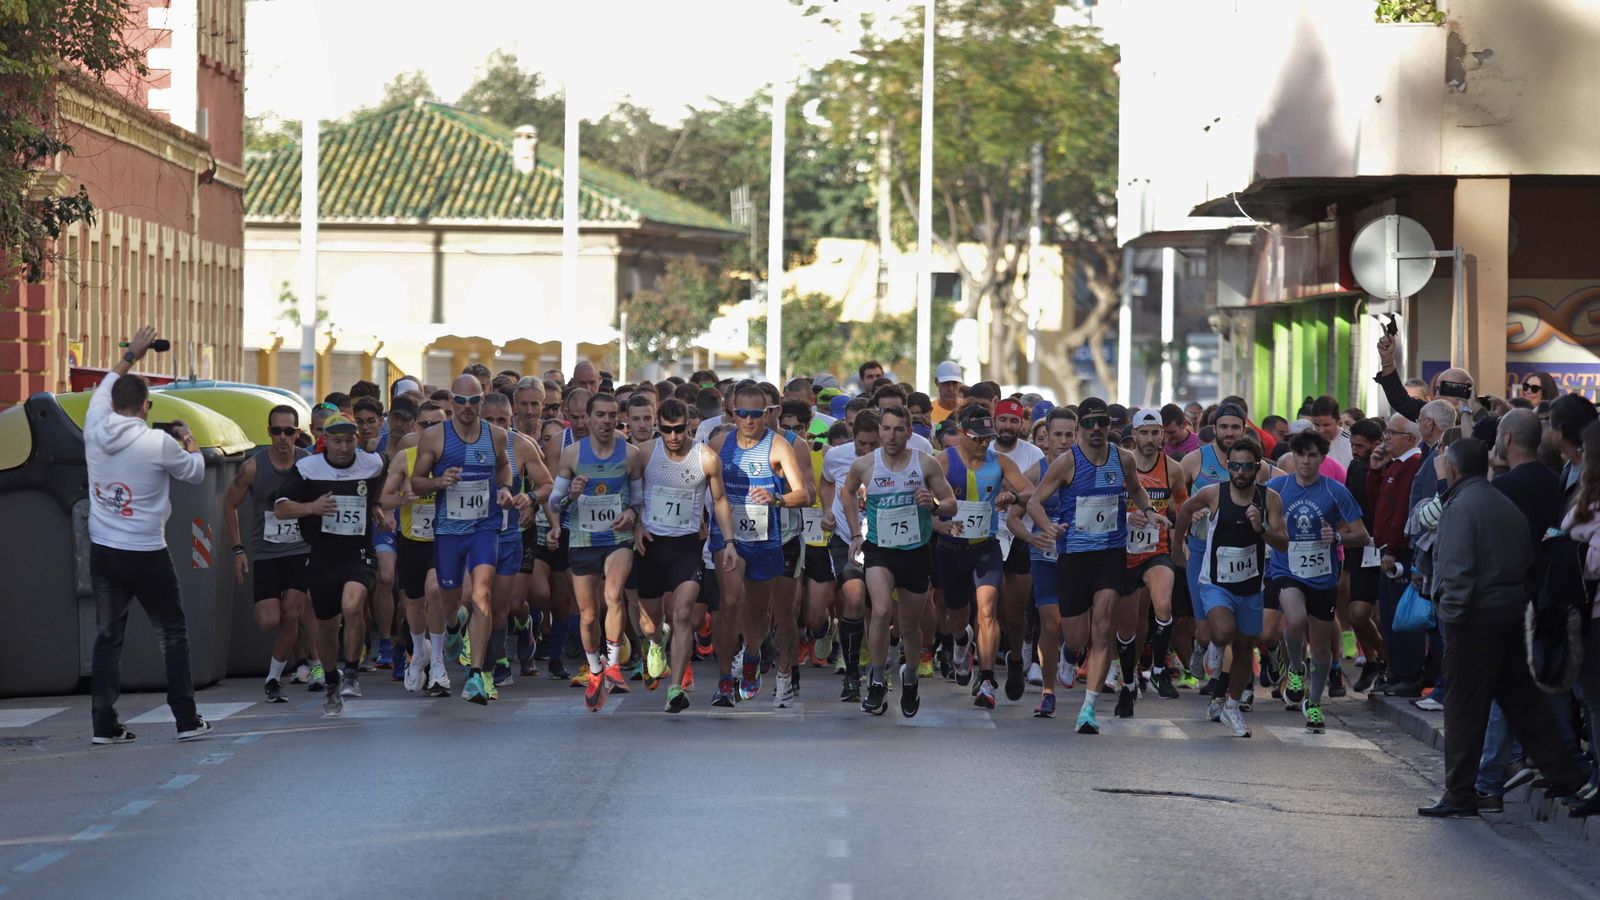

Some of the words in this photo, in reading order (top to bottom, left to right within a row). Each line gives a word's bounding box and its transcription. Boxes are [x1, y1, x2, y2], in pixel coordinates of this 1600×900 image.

[459, 495, 483, 509] 140
[665, 502, 681, 516] 71
[335, 510, 360, 524] 155
[590, 509, 615, 522] 160
[966, 515, 984, 528] 57
[1096, 510, 1104, 523] 6
[276, 523, 300, 536] 173
[739, 518, 756, 531] 82
[803, 521, 814, 532] 7
[890, 520, 909, 535] 75
[1129, 531, 1152, 545] 191
[1229, 557, 1252, 573] 104
[1300, 553, 1325, 568] 255
